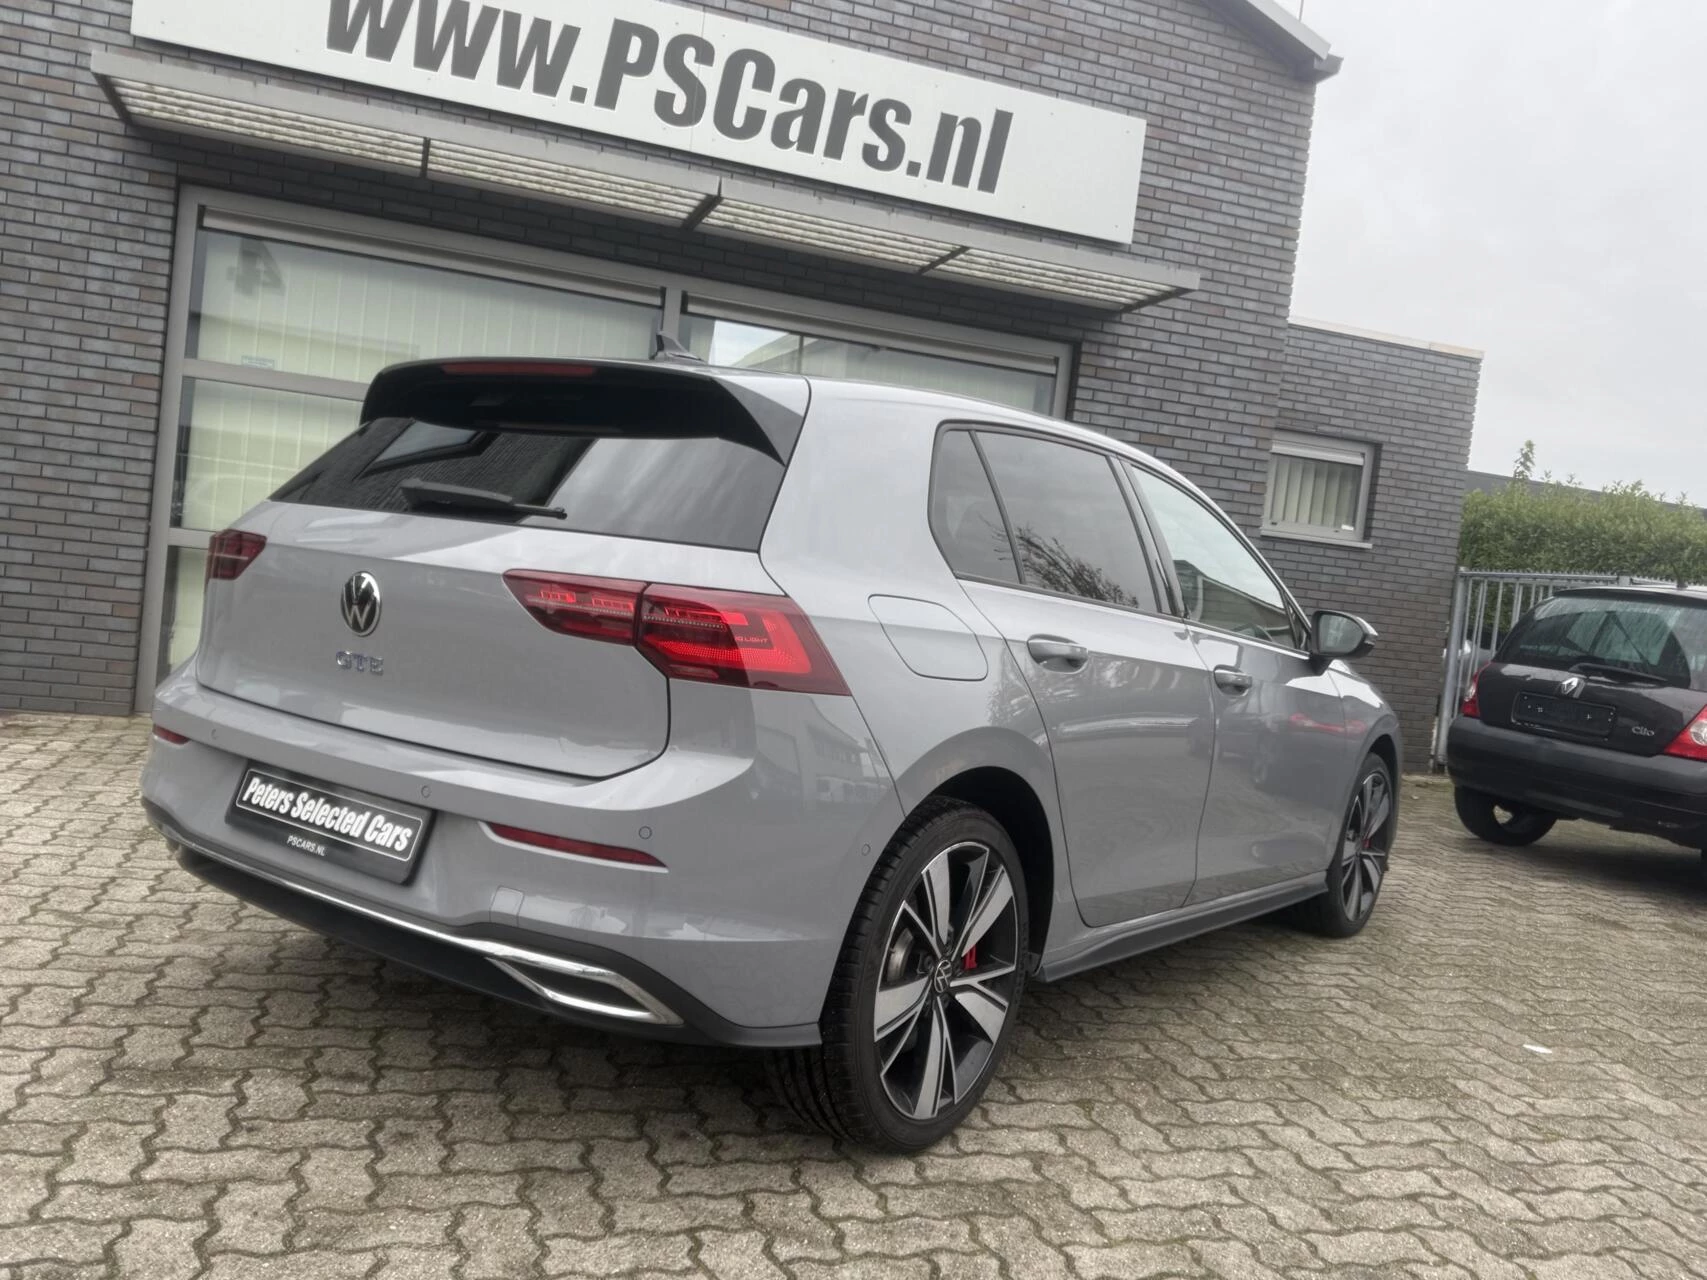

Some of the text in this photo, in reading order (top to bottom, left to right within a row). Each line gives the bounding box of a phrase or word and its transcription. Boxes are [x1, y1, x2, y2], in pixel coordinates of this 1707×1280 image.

[326, 0, 1013, 194] www.PSCars.nl
[336, 650, 384, 676] GTE
[243, 777, 412, 851] Peters Selected Cars
[286, 835, 325, 857] PSCARS.NL
